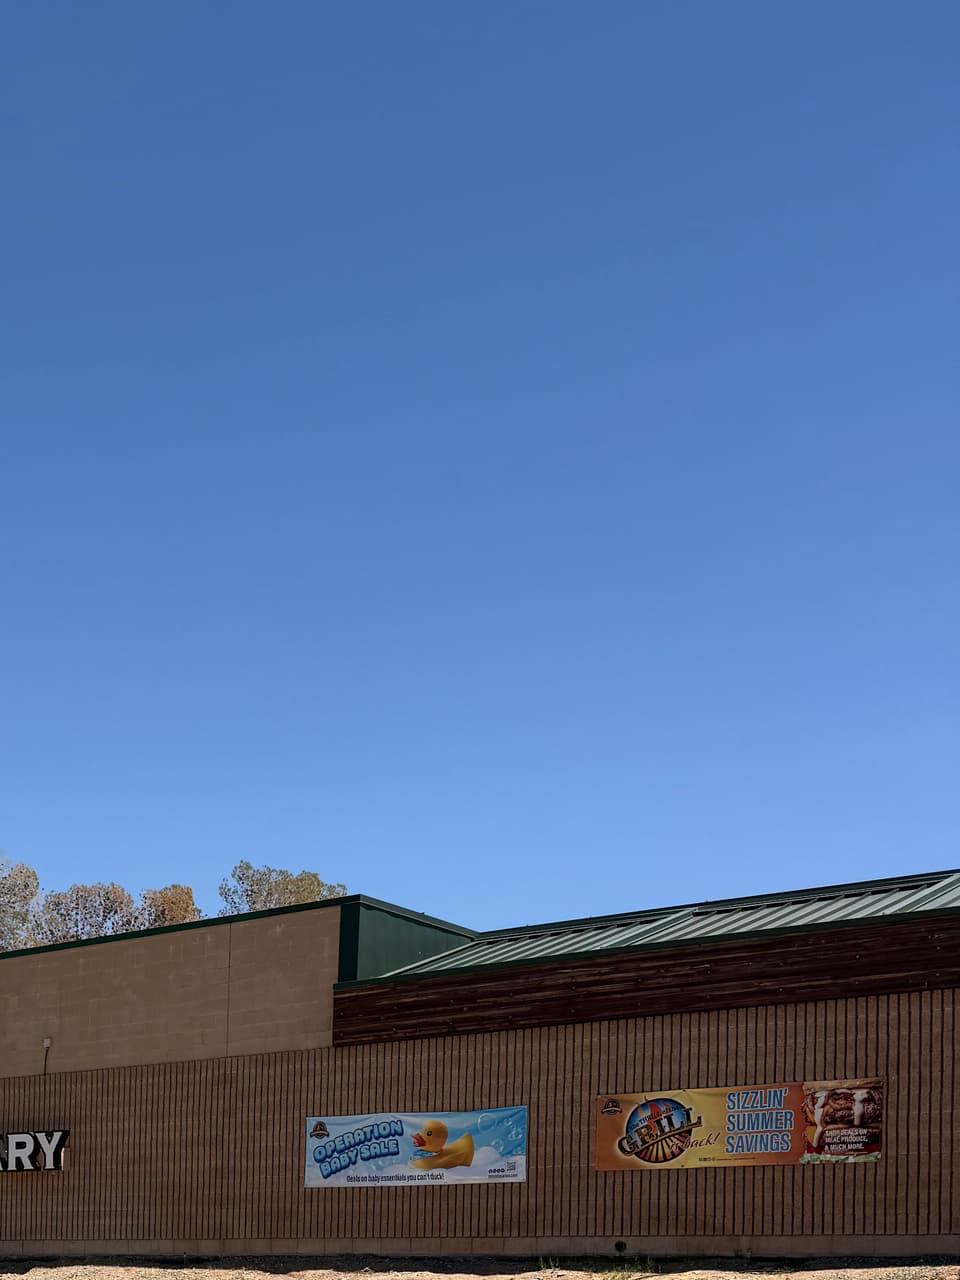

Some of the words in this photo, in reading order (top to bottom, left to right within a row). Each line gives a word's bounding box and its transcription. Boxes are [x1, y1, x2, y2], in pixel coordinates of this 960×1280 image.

[726, 1088, 788, 1110] SIZZLIN'
[618, 1107, 702, 1154] GRILL
[726, 1110, 794, 1132] SUMMER
[313, 1119, 404, 1163] OPERATION
[684, 1132, 721, 1149] back!
[725, 1132, 791, 1153] SAVINGS
[319, 1148, 358, 1179] BABY
[359, 1139, 399, 1161] SALE
[368, 1174, 380, 1183] baby
[407, 1174, 416, 1182] you
